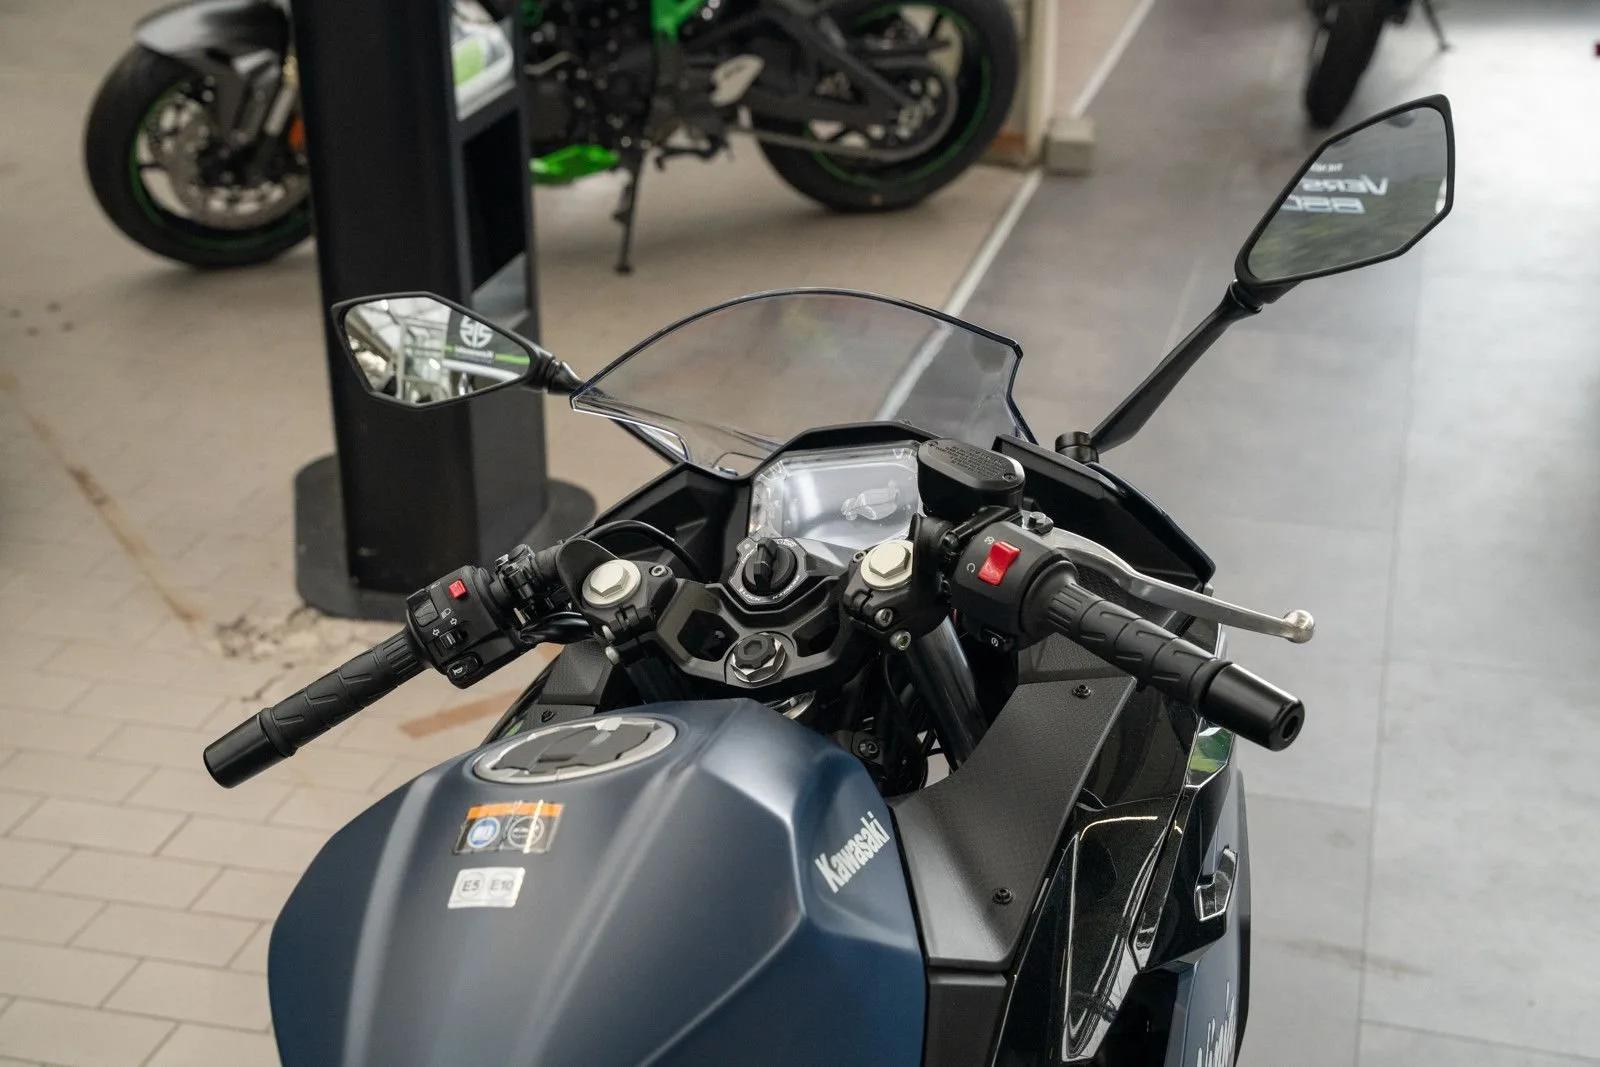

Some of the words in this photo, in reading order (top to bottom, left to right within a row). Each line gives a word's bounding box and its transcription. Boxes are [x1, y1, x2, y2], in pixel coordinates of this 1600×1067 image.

[814, 810, 890, 893] Kawasaki
[462, 880, 481, 892] E5
[490, 880, 514, 891] E10
